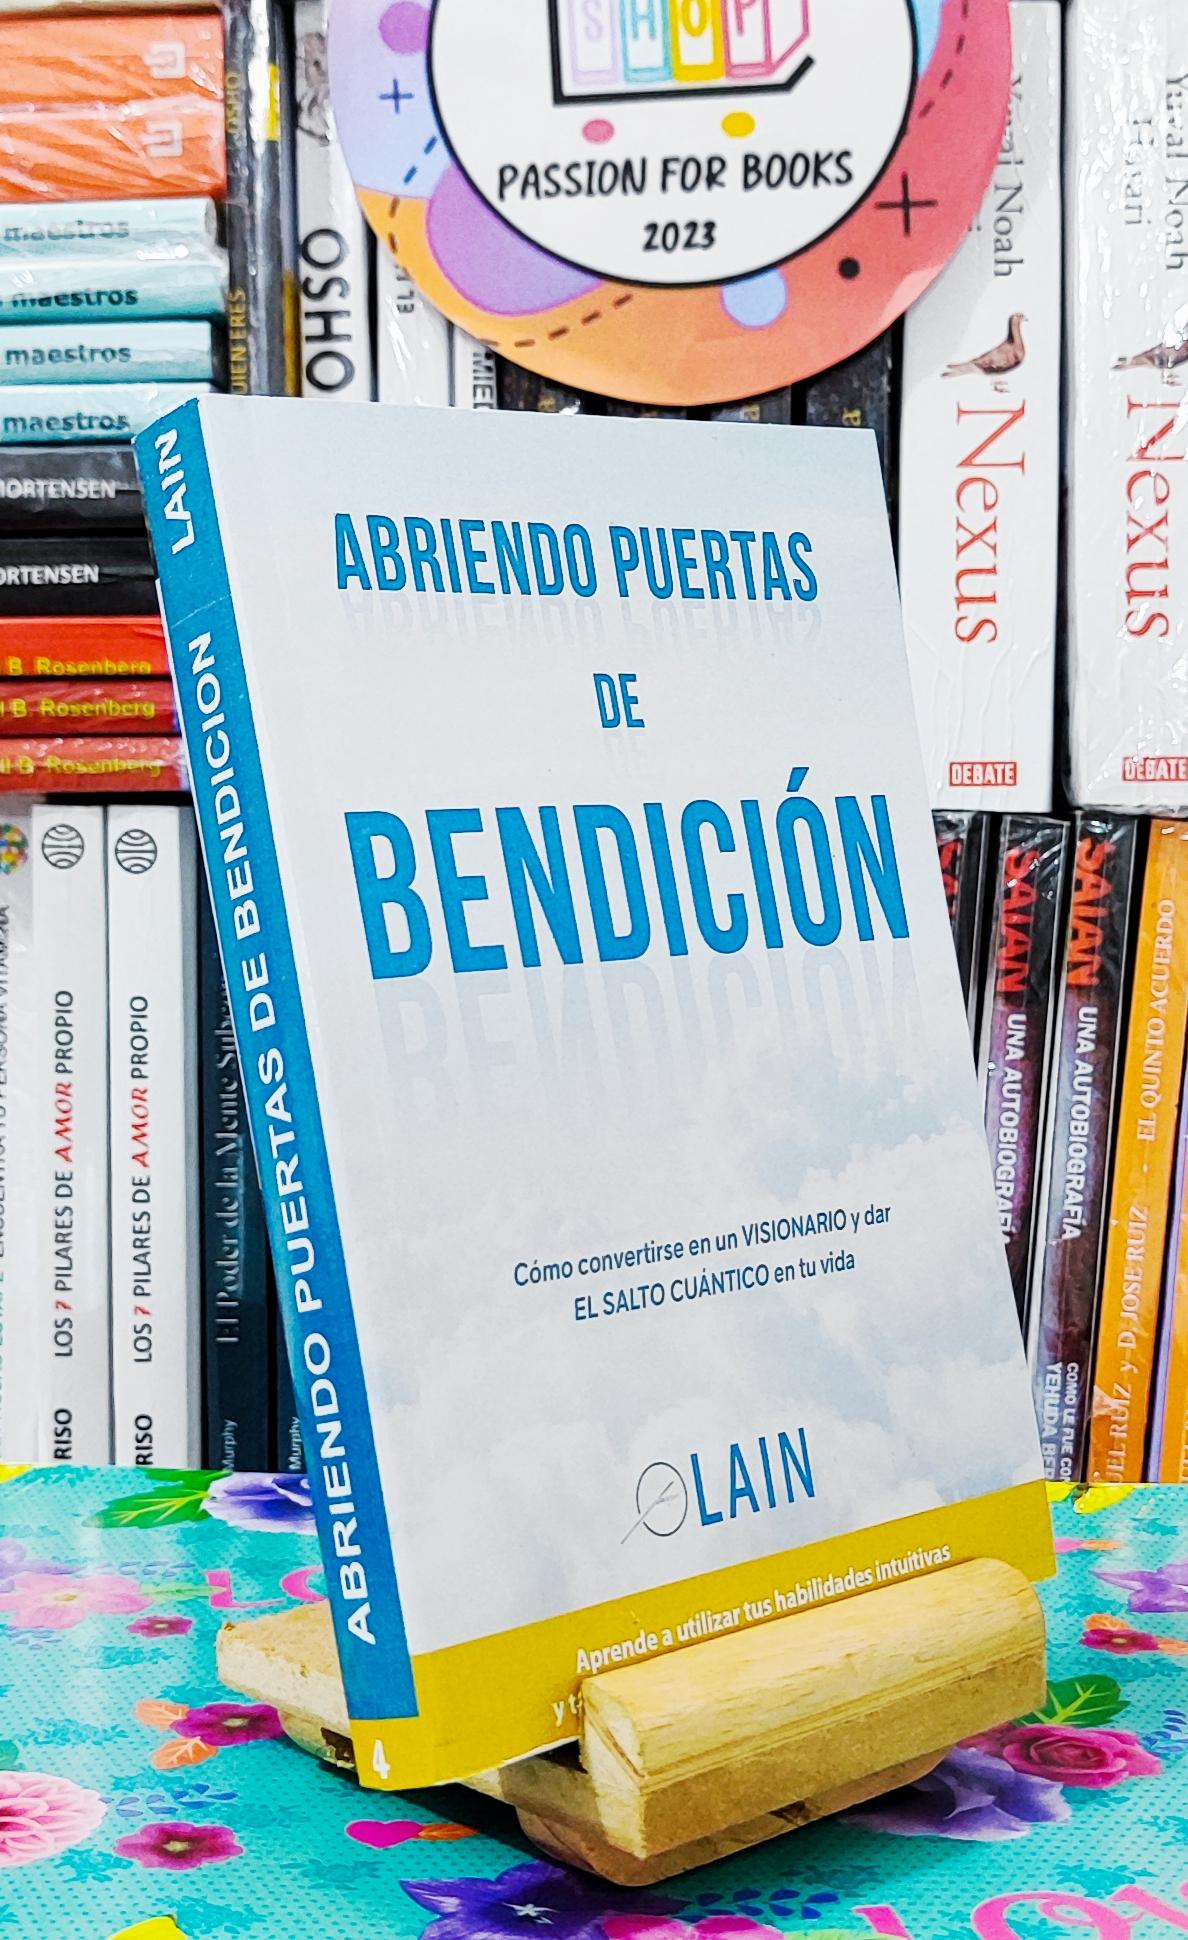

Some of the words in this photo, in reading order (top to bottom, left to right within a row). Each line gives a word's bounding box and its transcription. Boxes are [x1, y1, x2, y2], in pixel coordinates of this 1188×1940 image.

[498, 157, 647, 200] PASSION
[660, 155, 727, 194] FOR
[743, 151, 854, 190] BOOKS
[642, 221, 717, 252] 2023
[993, 184, 1024, 278] Noah
[12, 289, 139, 307] maestros
[228, 287, 246, 340] ERES
[301, 228, 355, 393] OSHO
[6, 345, 131, 365] maestros
[3, 412, 130, 433] maestros
[155, 428, 195, 554] LAIN
[1124, 394, 1188, 638] Nexus
[954, 399, 1026, 644] Nexus
[334, 513, 597, 598] ABRIENDO
[609, 526, 818, 601] PUERTAS
[39, 697, 155, 720] Rosenberg
[593, 673, 645, 728] DE
[46, 755, 161, 778] Rosenberg
[188, 631, 262, 940] BENDICION
[951, 763, 1015, 785] DEBATE
[1124, 759, 1187, 781] DEBATE
[344, 767, 910, 980] BENDICIÓN
[1150, 899, 1176, 1014] ACUERDO
[242, 952, 277, 1032] DE
[55, 990, 73, 1074] PROPIO
[130, 996, 149, 1079] PROPIO
[1005, 1014, 1027, 1061] UNA
[1075, 1006, 1098, 1054] UNA
[1140, 1017, 1165, 1108] QUINTO
[55, 1082, 73, 1162] AMOR
[130, 1087, 150, 1168] AMOR
[214, 1078, 239, 1156] Mente
[1136, 1119, 1157, 1143] EL
[1062, 1060, 1093, 1239] AUTOBIOGRAFÍA
[55, 1170, 73, 1198] DE
[132, 1175, 150, 1203] DE
[215, 1168, 239, 1189] la
[258, 1046, 323, 1313] PUERTAS
[215, 1197, 239, 1227] de
[1125, 1205, 1149, 1262] RUIZ
[54, 1206, 73, 1291] PILARES
[132, 1210, 151, 1297] PILARES
[215, 1236, 240, 1307] Poder
[514, 1259, 573, 1287] Cómo
[577, 1240, 684, 1276] convertirse
[688, 1237, 711, 1256] en
[716, 1230, 738, 1251] un
[742, 1208, 847, 1247] VISIONARIO
[850, 1213, 860, 1234] y
[864, 1203, 891, 1227] dar
[55, 1300, 73, 1311] 7
[134, 1305, 151, 1316] 7
[574, 1296, 598, 1320] EL
[602, 1284, 666, 1315] SALTO
[671, 1265, 769, 1303] CUÁNTICO
[774, 1266, 796, 1284] en
[799, 1260, 816, 1279] tu
[820, 1249, 855, 1274] vida
[54, 1317, 73, 1357] LOS
[133, 1322, 152, 1362] LOS
[215, 1317, 239, 1343] El
[1064, 1362, 1079, 1406] COMO
[1121, 1363, 1138, 1375] y
[1042, 1362, 1062, 1444] YEHUDA
[1063, 1409, 1076, 1425] LE
[1110, 1382, 1131, 1439] RUIZ
[54, 1408, 73, 1460] RISO
[135, 1414, 153, 1465] RISO
[289, 1417, 302, 1470] Murphy
[1062, 1427, 1075, 1454] FUE
[304, 1332, 377, 1645] ABRIENDO
[690, 1427, 815, 1526] LAIN
[576, 1631, 658, 1675] Aprende
[662, 1627, 673, 1646] a
[676, 1606, 740, 1643] utilizar
[744, 1600, 772, 1621] tus
[775, 1569, 873, 1612] habilidades
[875, 1544, 951, 1582] intuitivas
[551, 1700, 564, 1727] y
[371, 1738, 391, 1780] 4
